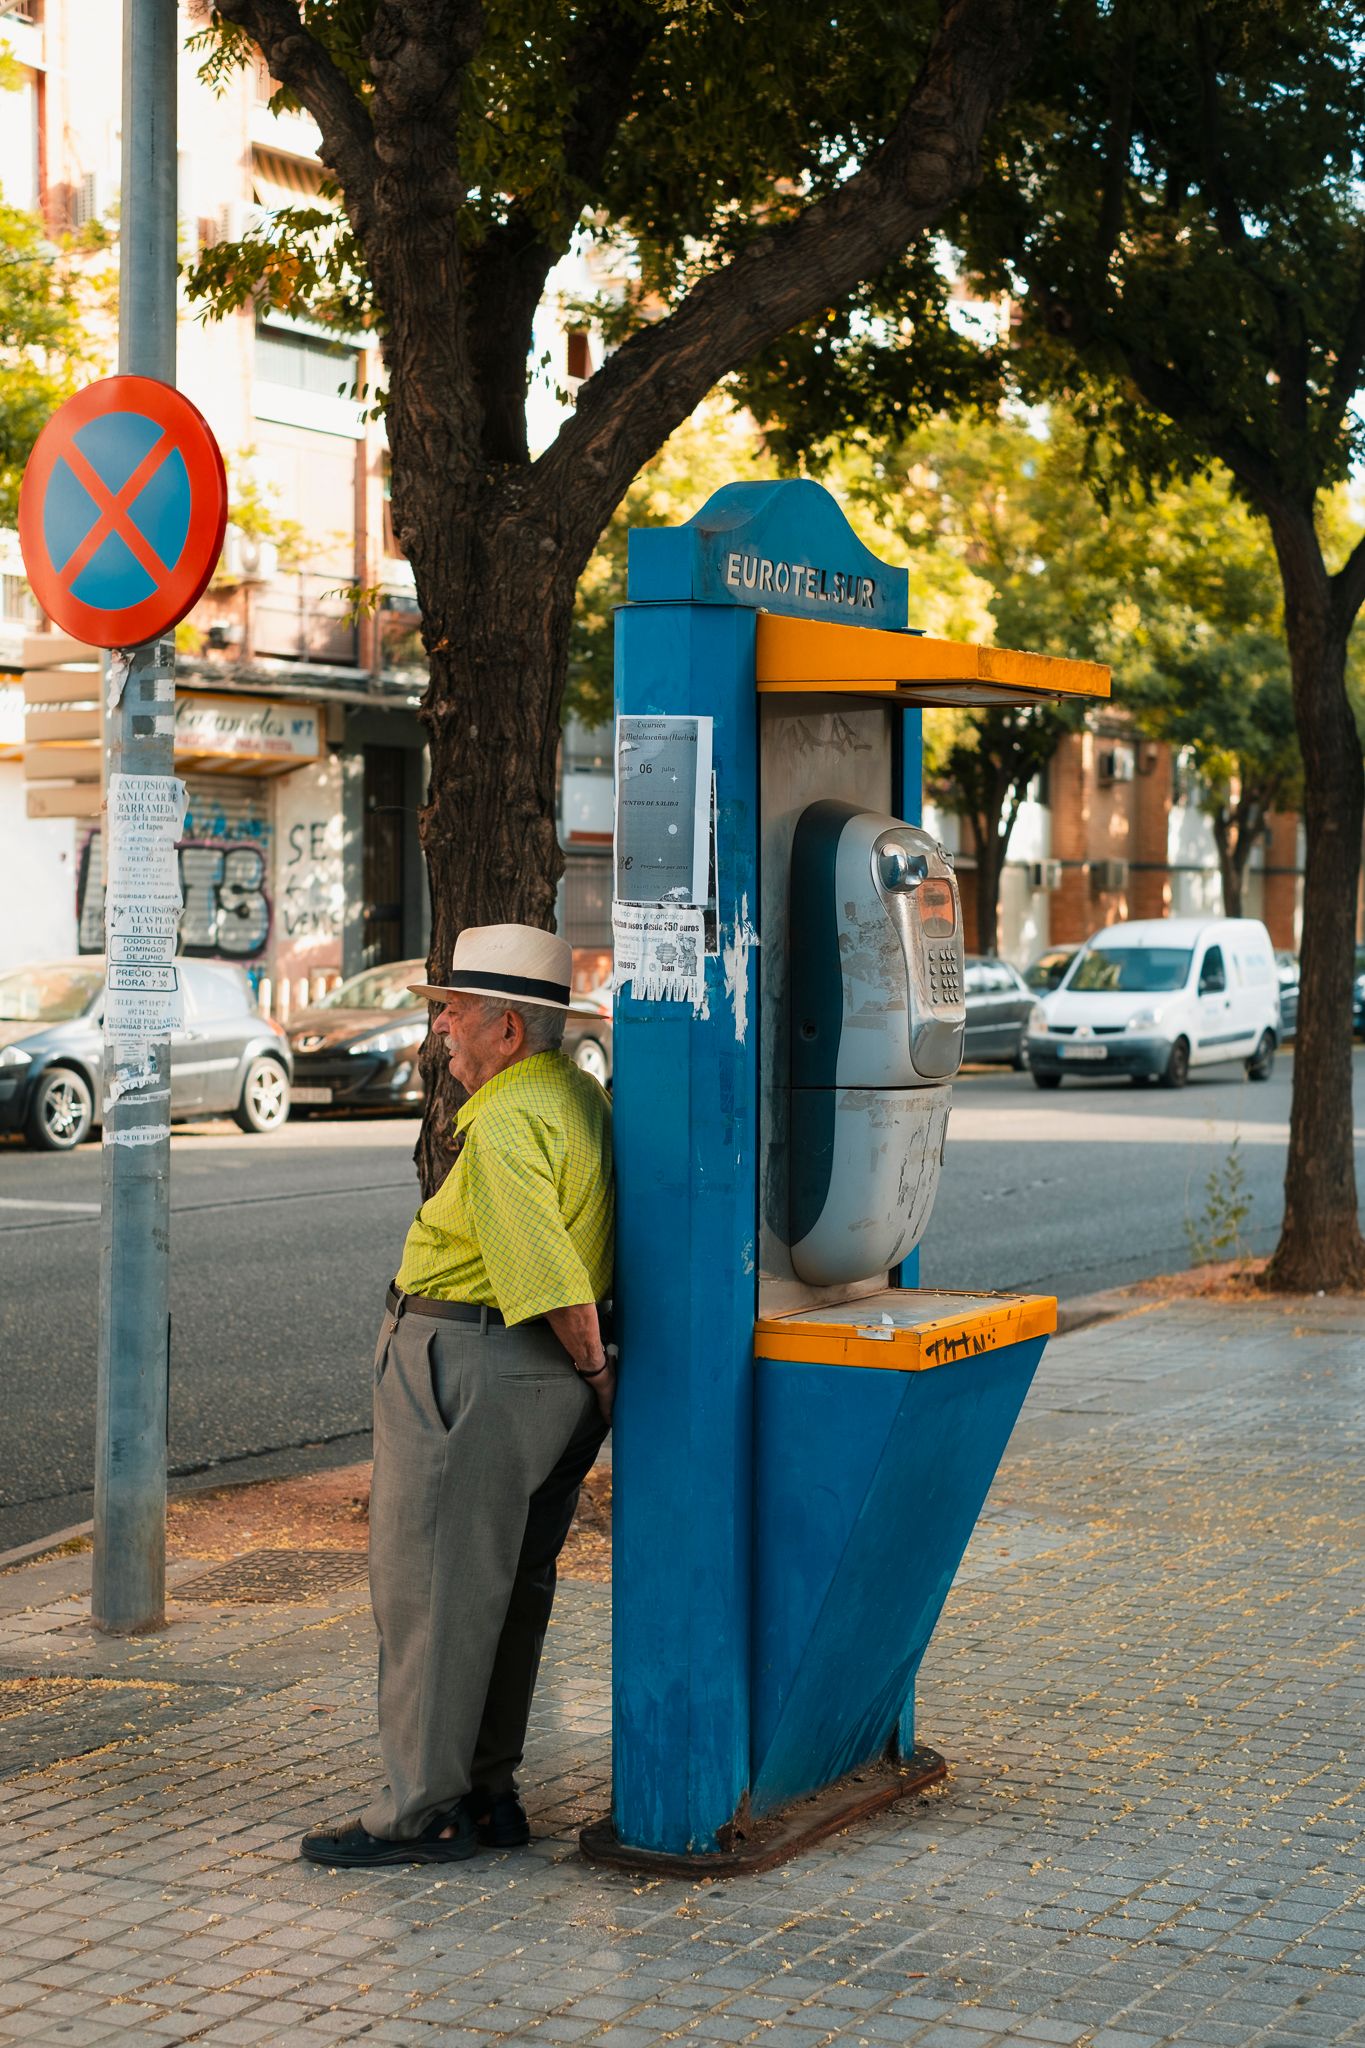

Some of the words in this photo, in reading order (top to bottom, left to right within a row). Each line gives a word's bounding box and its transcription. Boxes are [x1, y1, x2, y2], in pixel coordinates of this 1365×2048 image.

[726, 552, 876, 609] EUROTELSUR
[625, 733, 668, 741] Matalascañas
[639, 763, 653, 774] 06
[661, 766, 676, 774] julio
[132, 813, 141, 821] de
[142, 813, 149, 821] la
[138, 822, 145, 830] el
[287, 822, 328, 867] SE
[132, 925, 142, 934] DE
[680, 924, 700, 932] euros
[123, 945, 167, 953] DOMINGOS
[117, 978, 149, 988] HORA:
[151, 979, 168, 988] 7:30
